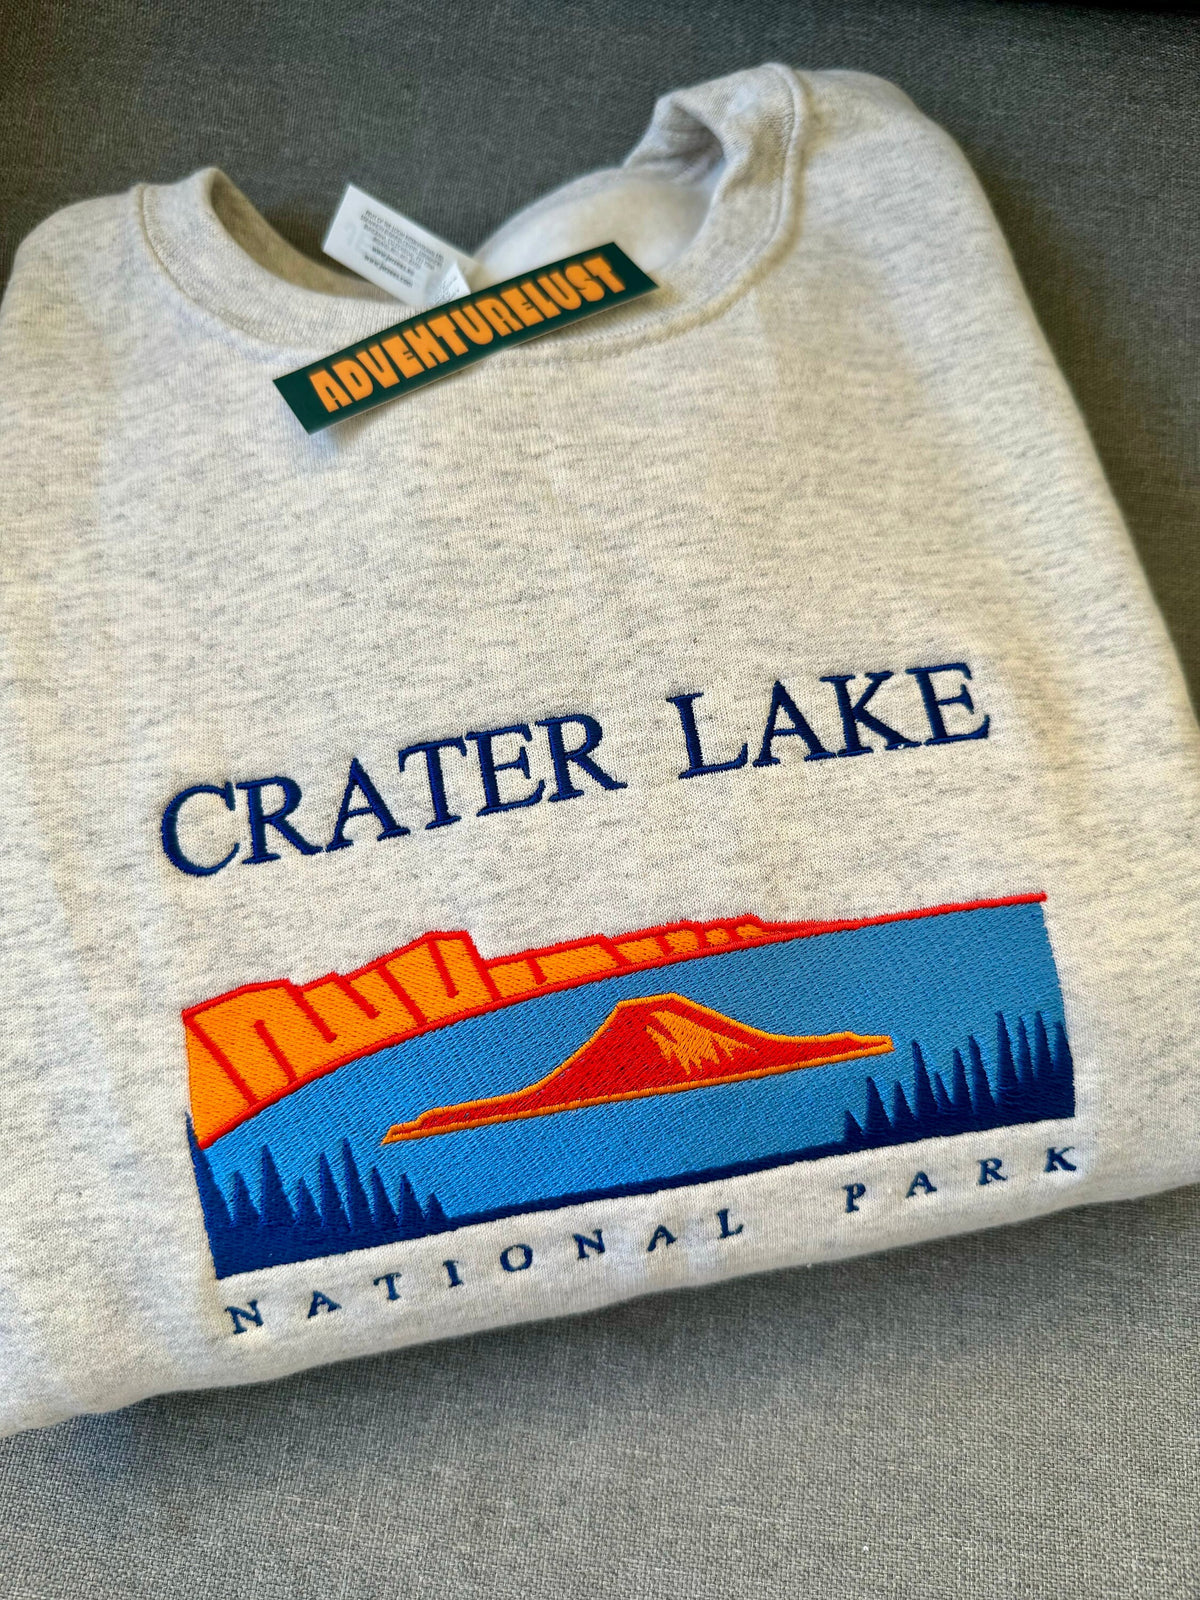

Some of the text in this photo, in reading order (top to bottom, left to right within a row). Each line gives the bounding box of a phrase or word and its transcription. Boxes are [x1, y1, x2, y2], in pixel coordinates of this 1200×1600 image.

[309, 255, 625, 412] ADVENTURELUST
[160, 661, 991, 878] CRATER LAKE
[225, 1146, 1077, 1335] NATIONAL PARK
